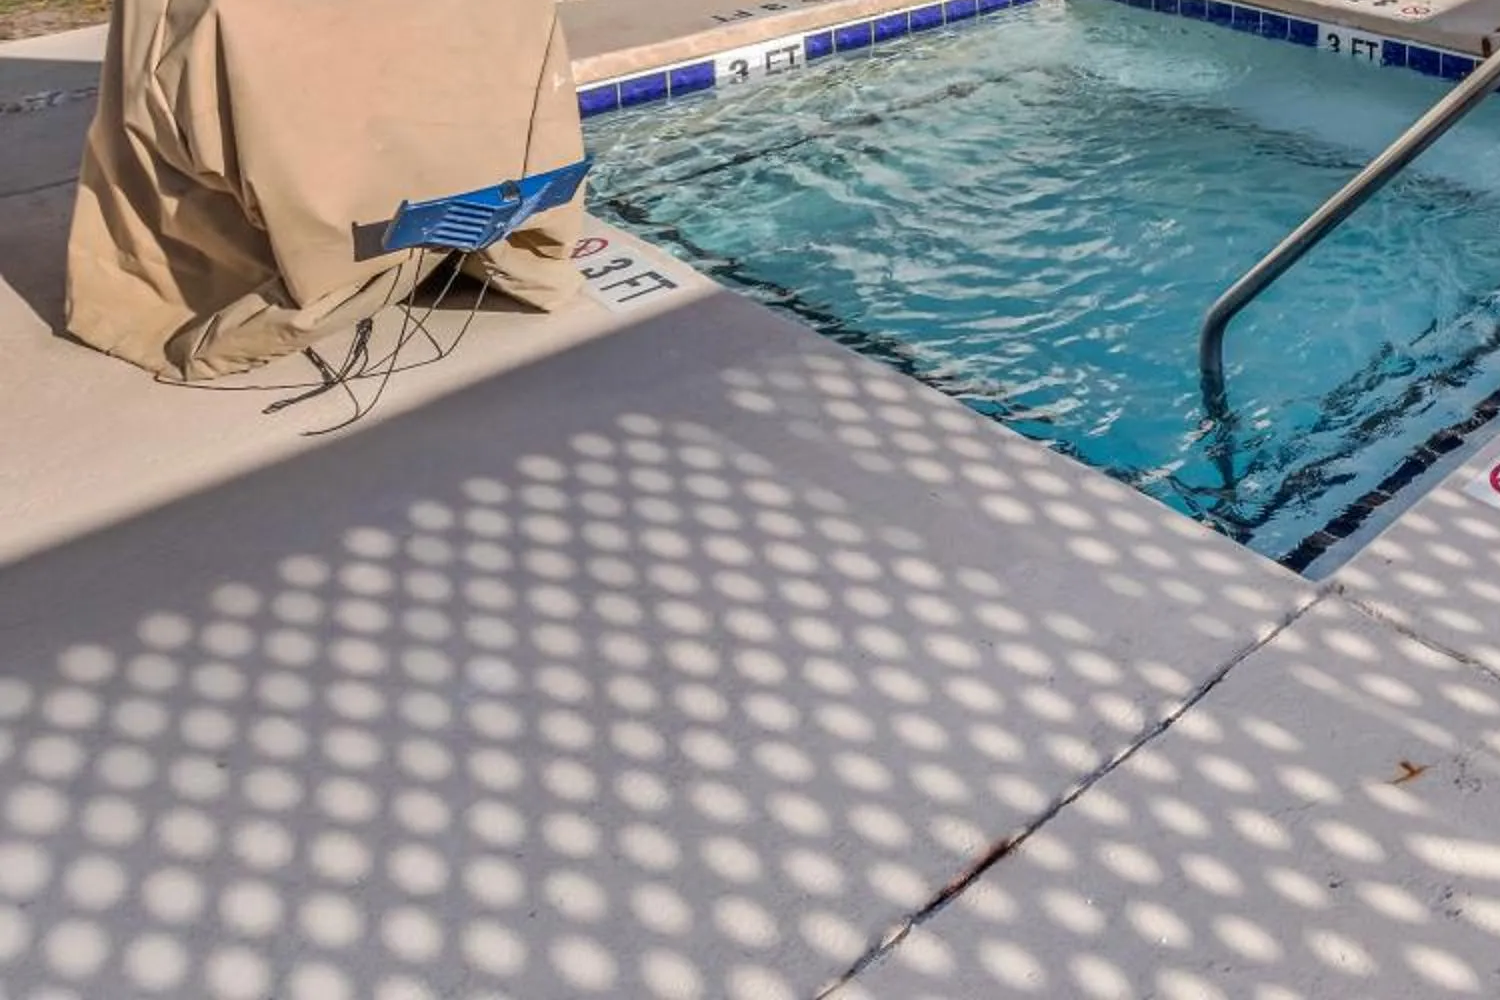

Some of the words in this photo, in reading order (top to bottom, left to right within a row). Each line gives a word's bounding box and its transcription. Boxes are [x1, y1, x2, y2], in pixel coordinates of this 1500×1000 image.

[1327, 33, 1341, 53] 3
[1351, 37, 1379, 61] FT
[729, 59, 750, 84] 3
[765, 43, 801, 73] FT
[579, 257, 634, 280] 3
[600, 270, 679, 304] FT
